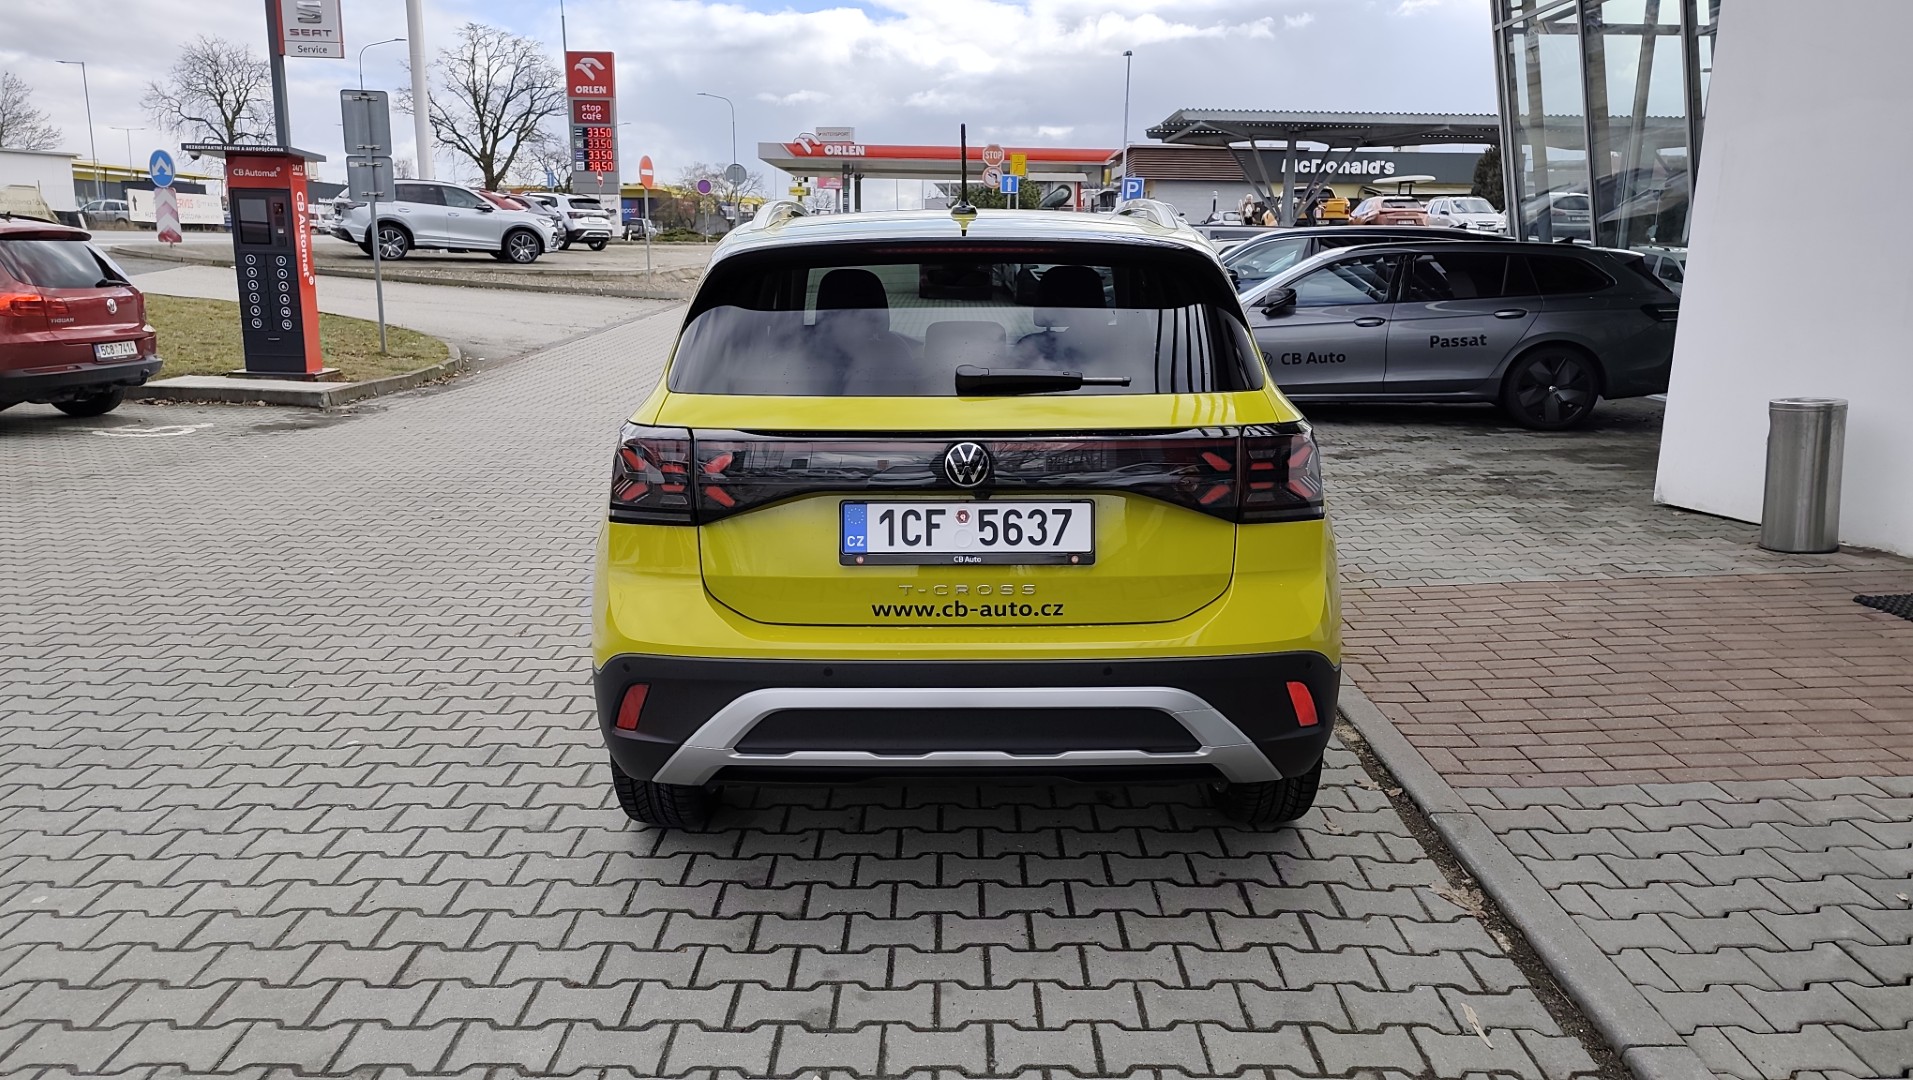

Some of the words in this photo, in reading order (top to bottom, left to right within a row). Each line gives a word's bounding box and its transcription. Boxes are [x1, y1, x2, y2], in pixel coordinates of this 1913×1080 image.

[289, 28, 332, 37] SEAT
[297, 45, 328, 54] Service
[575, 85, 607, 94] ORLEN
[581, 103, 602, 113] stop
[581, 112, 602, 121] cafe
[587, 127, 612, 138] 33.50
[587, 139, 612, 149] 33.50
[588, 150, 613, 160] 33.50
[824, 144, 865, 156] ORLEN
[985, 150, 1002, 160] STOP
[233, 168, 244, 176] CB
[245, 168, 277, 177] Automat
[1126, 181, 1140, 199] P
[296, 191, 305, 212] CB
[298, 213, 309, 278] Automat
[1429, 334, 1487, 348] Passat
[1281, 352, 1302, 365] CB
[1306, 352, 1346, 365] Auto
[879, 509, 946, 547] 1CF
[978, 509, 1073, 547] 5637
[847, 535, 865, 547] CZ
[953, 555, 964, 563] CB
[964, 555, 982, 563] Auto
[898, 584, 1037, 595] T-CROSS
[871, 600, 1064, 617] www.cb-auto.cz
